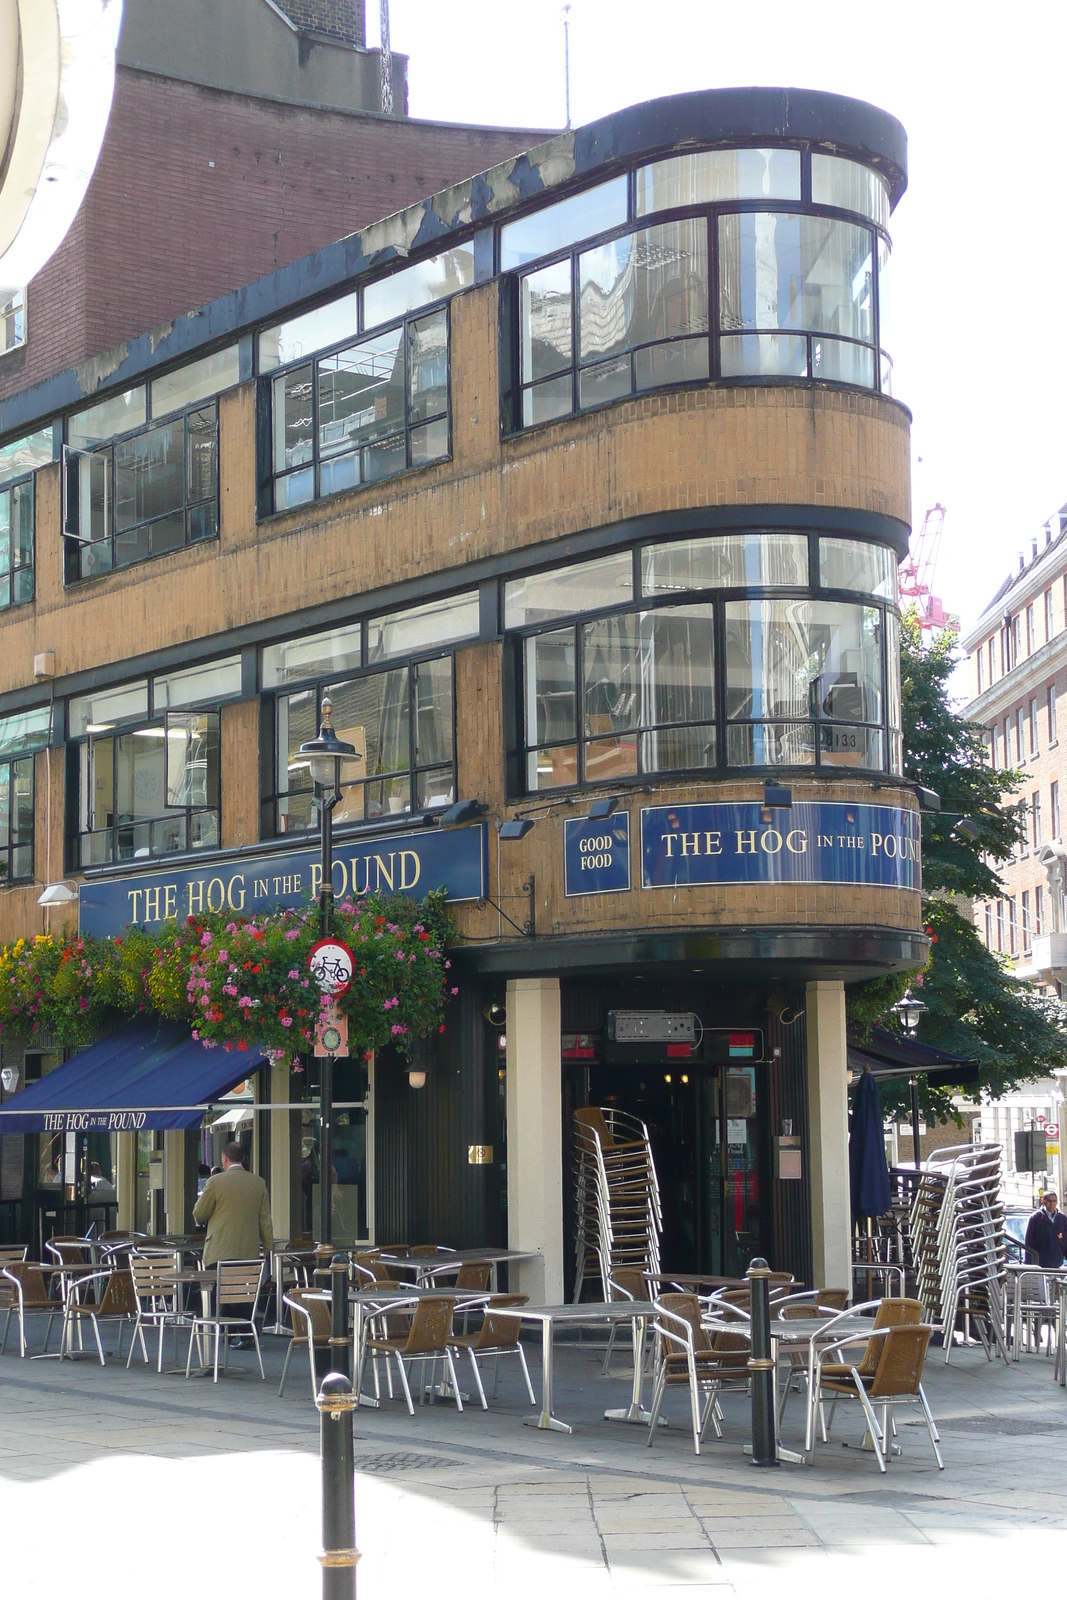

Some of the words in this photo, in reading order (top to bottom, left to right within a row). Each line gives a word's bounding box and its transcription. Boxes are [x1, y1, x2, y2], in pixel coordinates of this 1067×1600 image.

[579, 835, 613, 853] GOOD
[661, 831, 723, 858] THE
[734, 829, 809, 854] HOG
[817, 835, 834, 848] IN
[837, 836, 865, 849] THE
[870, 833, 921, 863] POUND
[580, 853, 613, 871] FOOD
[127, 884, 179, 924] THE
[186, 874, 246, 917] HOG
[253, 878, 269, 898] IN
[272, 874, 302, 896] THE
[309, 850, 421, 901] POUND
[43, 1114, 65, 1131] THE
[65, 1113, 90, 1130] HOG
[90, 1117, 97, 1126] IN
[97, 1116, 108, 1126] THE
[107, 1112, 147, 1130] POUND
